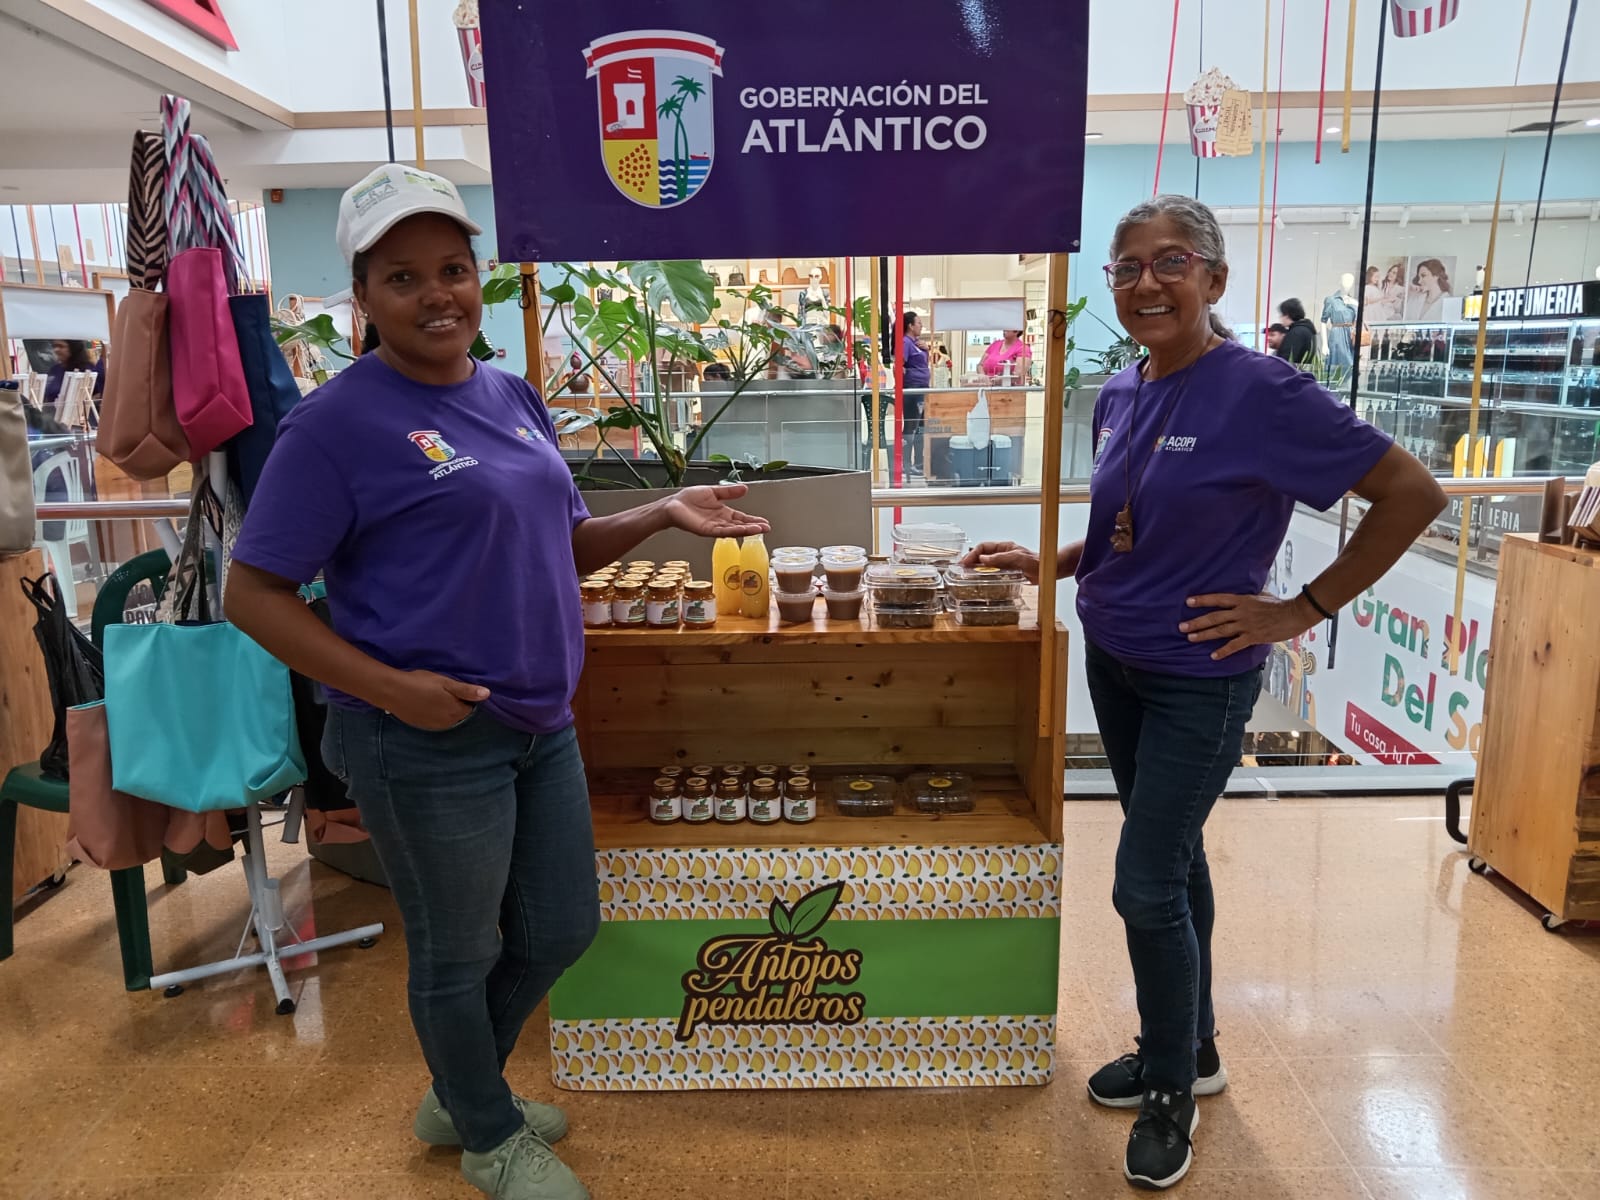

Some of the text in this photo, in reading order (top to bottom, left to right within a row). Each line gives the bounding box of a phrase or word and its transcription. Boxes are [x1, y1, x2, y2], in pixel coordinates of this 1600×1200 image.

[740, 80, 989, 108] GOBERNACIÓN DEL
[740, 108, 988, 153] ATLÁNTICO
[1487, 284, 1583, 318] PERFUMERIA
[1167, 436, 1197, 447] ACOPI
[1352, 586, 1430, 660] Gran
[1381, 652, 1437, 732] Del
[1351, 712, 1361, 735] Tu
[688, 935, 860, 997] Antojos
[682, 981, 862, 1037] pendaleros
